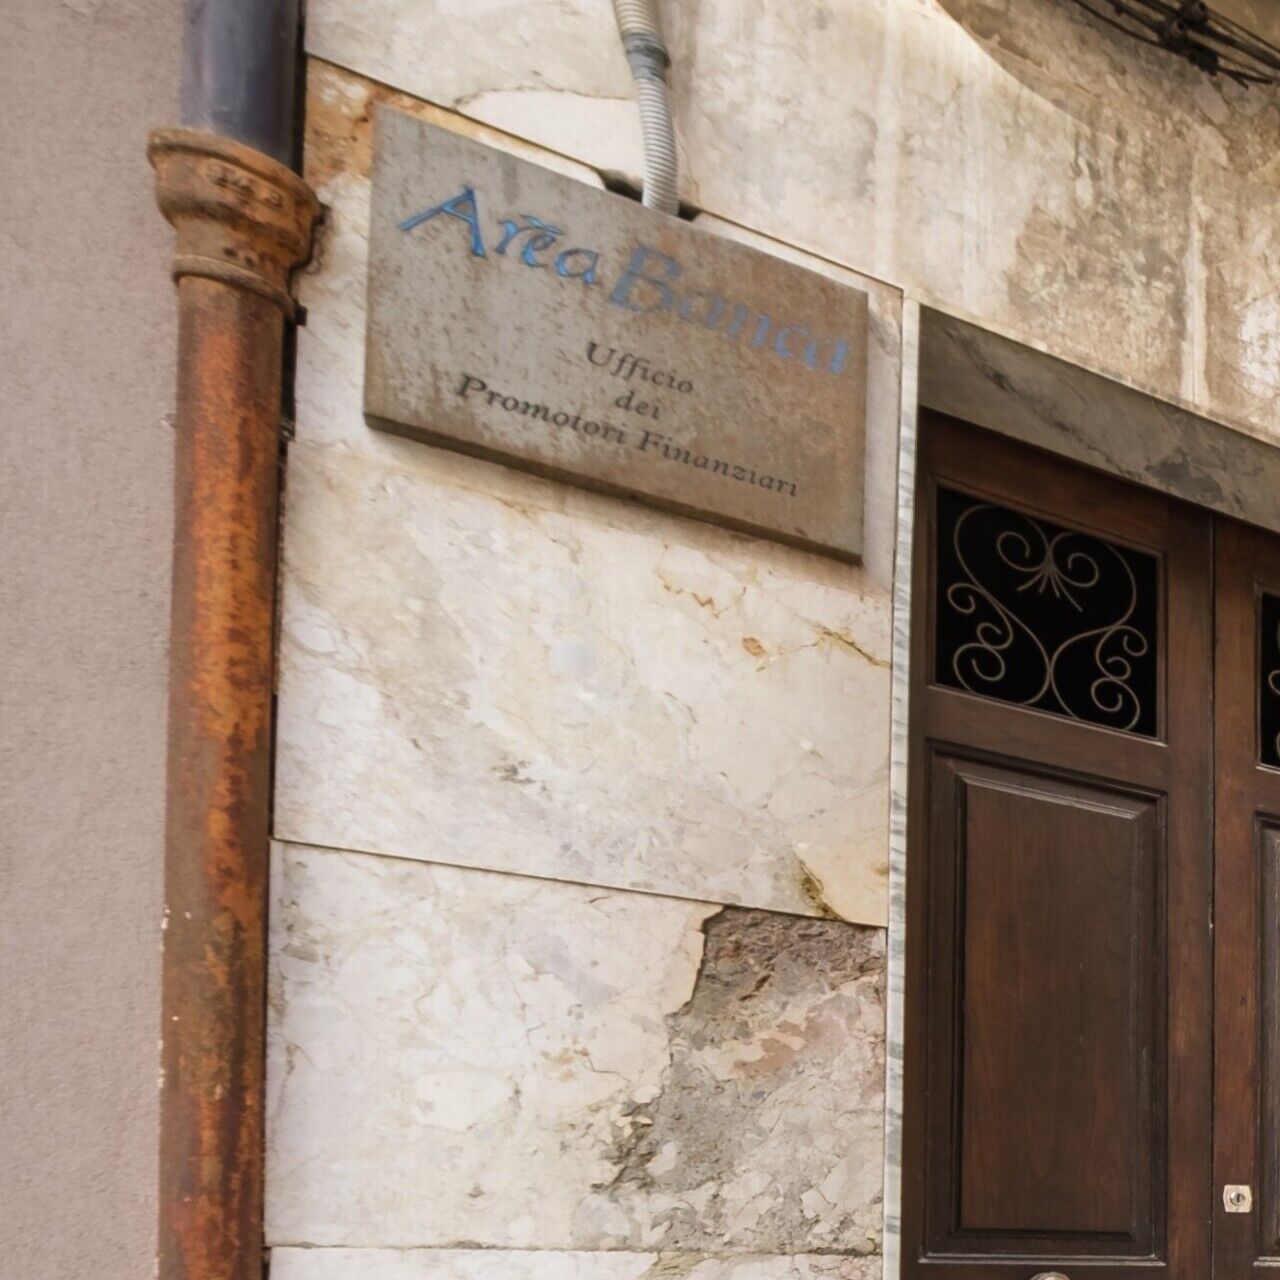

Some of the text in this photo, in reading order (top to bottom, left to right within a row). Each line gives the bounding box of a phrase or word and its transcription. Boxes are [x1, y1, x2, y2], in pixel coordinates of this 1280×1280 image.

[586, 339, 694, 396] Ufficio
[614, 387, 660, 420] dei
[455, 373, 799, 499] Promotori Finanziari
